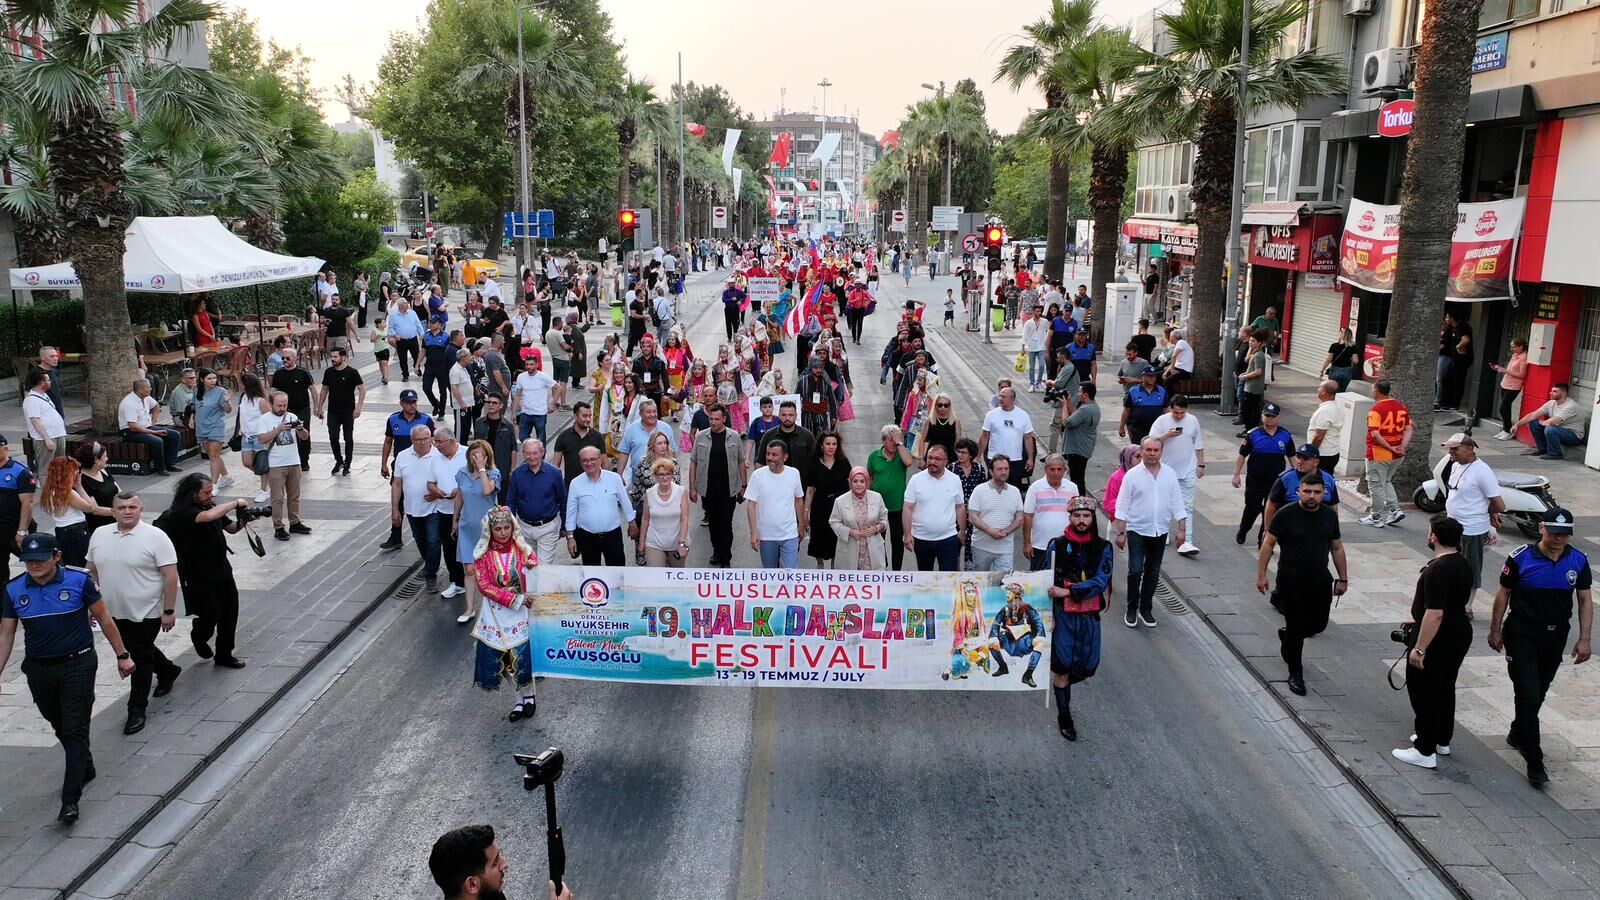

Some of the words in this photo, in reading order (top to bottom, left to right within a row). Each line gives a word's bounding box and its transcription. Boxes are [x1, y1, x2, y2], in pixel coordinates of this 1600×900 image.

[1383, 107, 1413, 128] Torku
[1160, 233, 1181, 245] KAYA
[1264, 241, 1296, 263] KIRTASİYE
[1380, 410, 1407, 433] 45
[666, 571, 689, 581] T.C.
[694, 570, 745, 581] DENİZLİ
[751, 570, 833, 583] BÜYÜKŞEHİR
[839, 572, 914, 584] BELEDİYESİ
[697, 583, 881, 600] ULUSLARARASI
[640, 606, 687, 639] 19.
[690, 600, 774, 639] HALK
[785, 603, 936, 641] DANSLARI
[566, 638, 597, 650] Bülent
[599, 639, 627, 653] Nuri
[545, 648, 641, 664] ÇAVUŞOĞLU
[690, 639, 888, 670] FESTİVALİ
[716, 670, 729, 680] 13
[742, 670, 756, 681] 19
[760, 671, 819, 681] TEMMUZ
[823, 670, 829, 682] /
[833, 671, 865, 682] JULY
